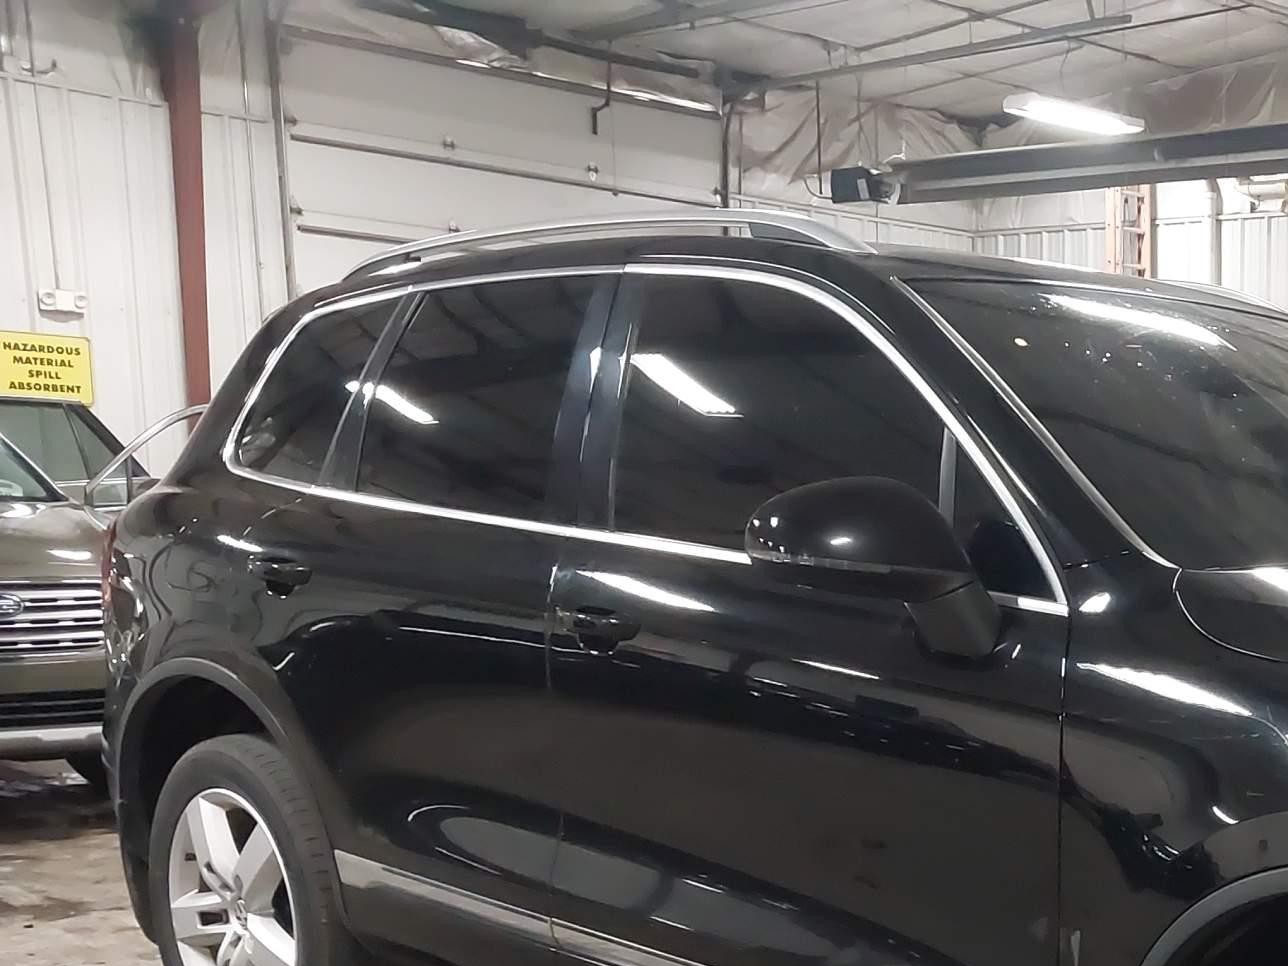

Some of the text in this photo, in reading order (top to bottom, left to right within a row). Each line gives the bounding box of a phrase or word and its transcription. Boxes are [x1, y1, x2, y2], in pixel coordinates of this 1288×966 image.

[2, 341, 81, 356] HAZARDOUS
[12, 355, 74, 368] MATERIAL
[27, 369, 62, 380] SPILL
[8, 381, 82, 394] ABSORBENT
